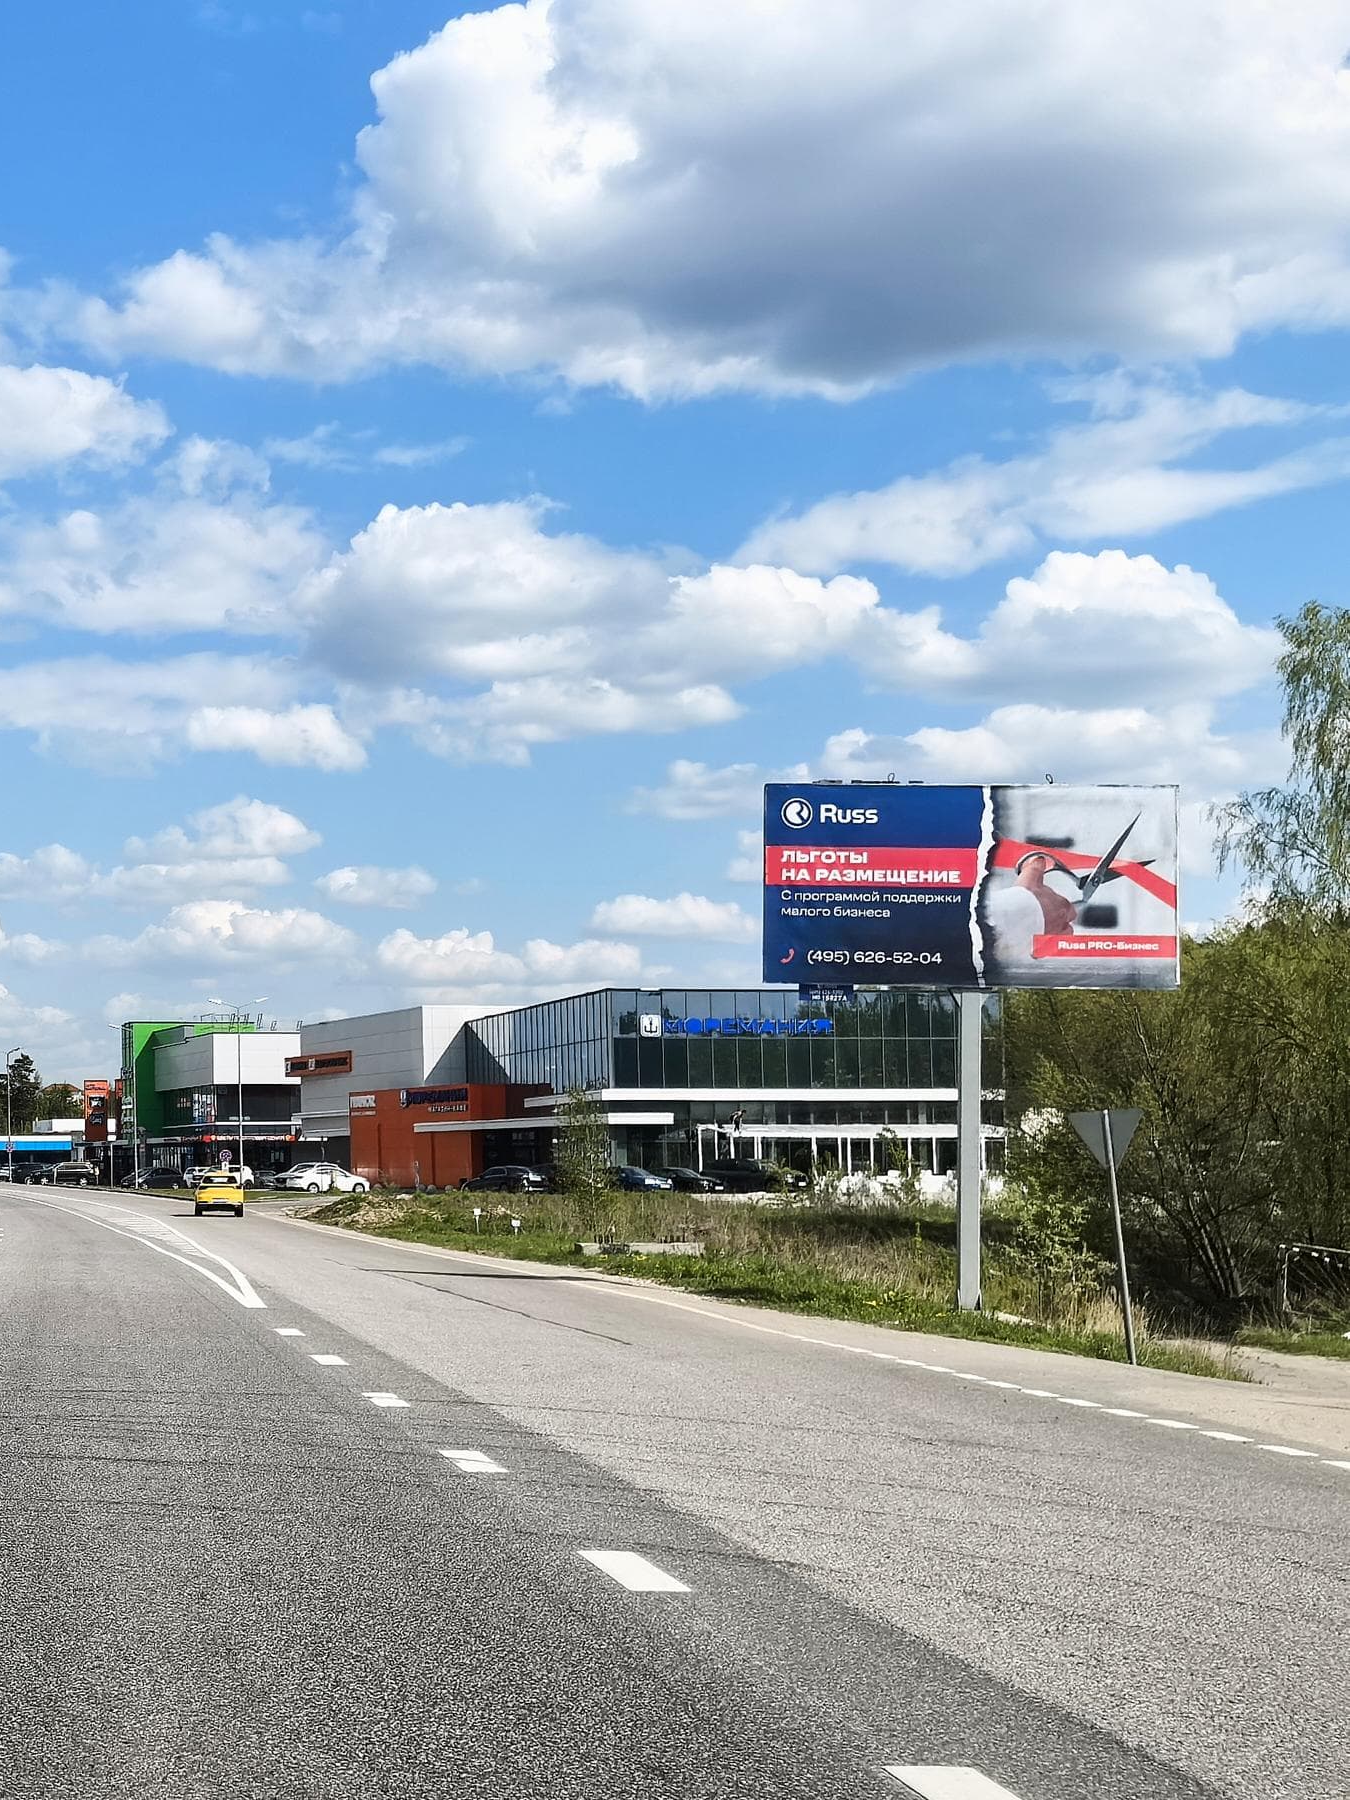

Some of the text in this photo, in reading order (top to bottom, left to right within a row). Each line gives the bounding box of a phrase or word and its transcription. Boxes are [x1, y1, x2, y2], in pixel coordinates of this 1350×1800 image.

[819, 803, 879, 824] Russ
[781, 850, 868, 864] ЛЬГОТЫ
[781, 868, 961, 885] НА РАЗМЕЩЕНИЕ
[781, 889, 962, 906] С программой поддержки
[781, 906, 891, 919] малого бизнеса
[807, 949, 943, 966] (495) 626-52-04
